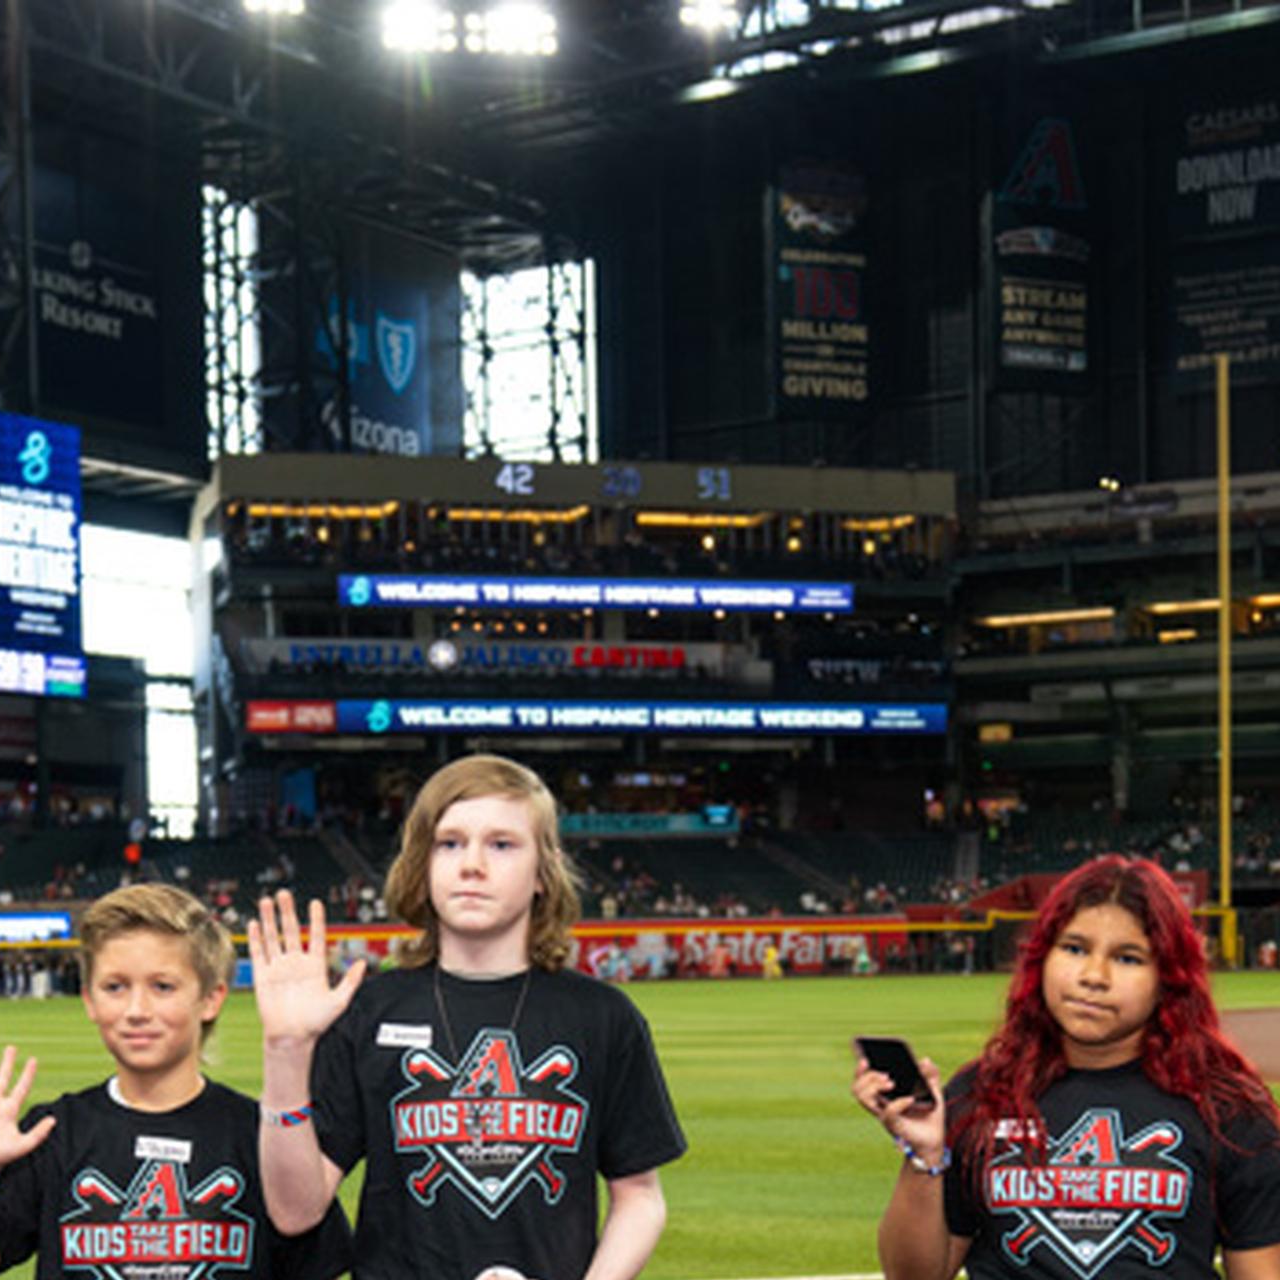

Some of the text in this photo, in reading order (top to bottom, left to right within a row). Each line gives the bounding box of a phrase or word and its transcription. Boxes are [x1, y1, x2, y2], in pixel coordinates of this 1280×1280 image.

[1207, 187, 1258, 226] NOW
[1001, 285, 1086, 309] STREAM
[780, 320, 868, 343] MILLION
[782, 376, 868, 400] GIVING
[495, 464, 535, 495] 42
[696, 467, 732, 500] 51
[376, 582, 478, 600] WELCOME
[483, 583, 509, 600] TO
[572, 646, 686, 668] CANTINA
[398, 706, 512, 725] WELCOME
[517, 707, 548, 725] TO
[551, 707, 650, 726] HISPANIC
[653, 708, 755, 727] HERITAGE
[758, 709, 864, 728] WEEKEND
[684, 929, 868, 965] State Farm
[398, 1103, 459, 1140] KIDS
[508, 1103, 581, 1140] FIELD
[992, 1169, 1186, 1206] KIDS TAKE THE FIELD
[64, 1225, 245, 1259] KIDS TAKE THE FIELD
